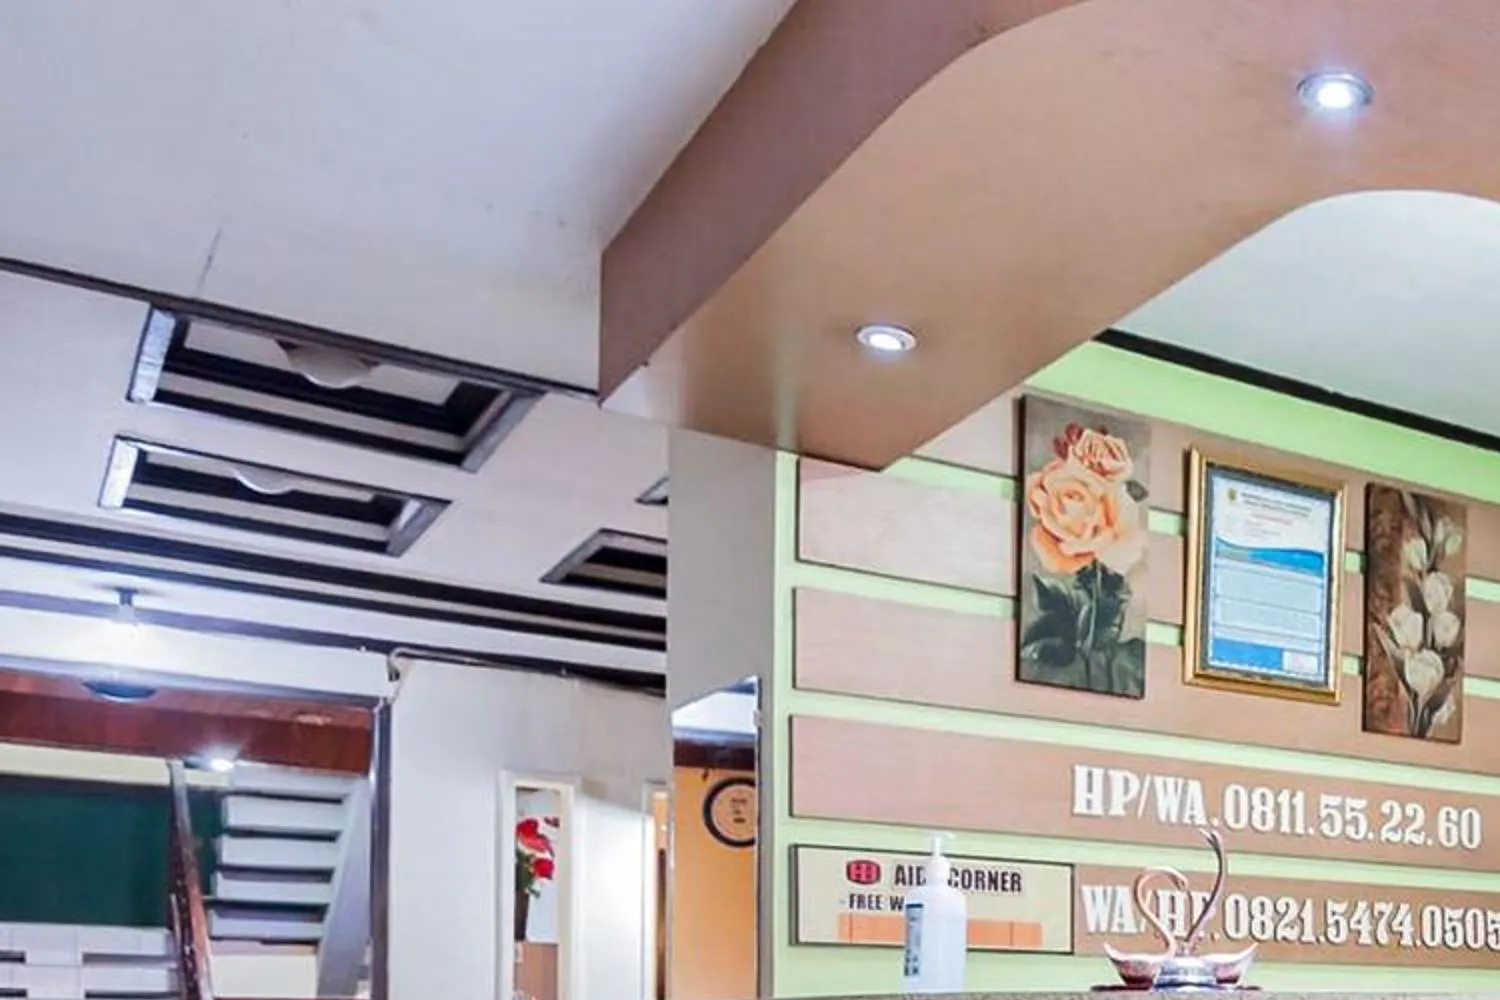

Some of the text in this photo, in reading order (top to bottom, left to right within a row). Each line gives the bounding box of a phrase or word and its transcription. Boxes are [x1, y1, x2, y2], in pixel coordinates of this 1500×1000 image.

[895, 864, 927, 887] AID
[947, 869, 1022, 893] CORNER
[849, 894, 882, 911] FREE
